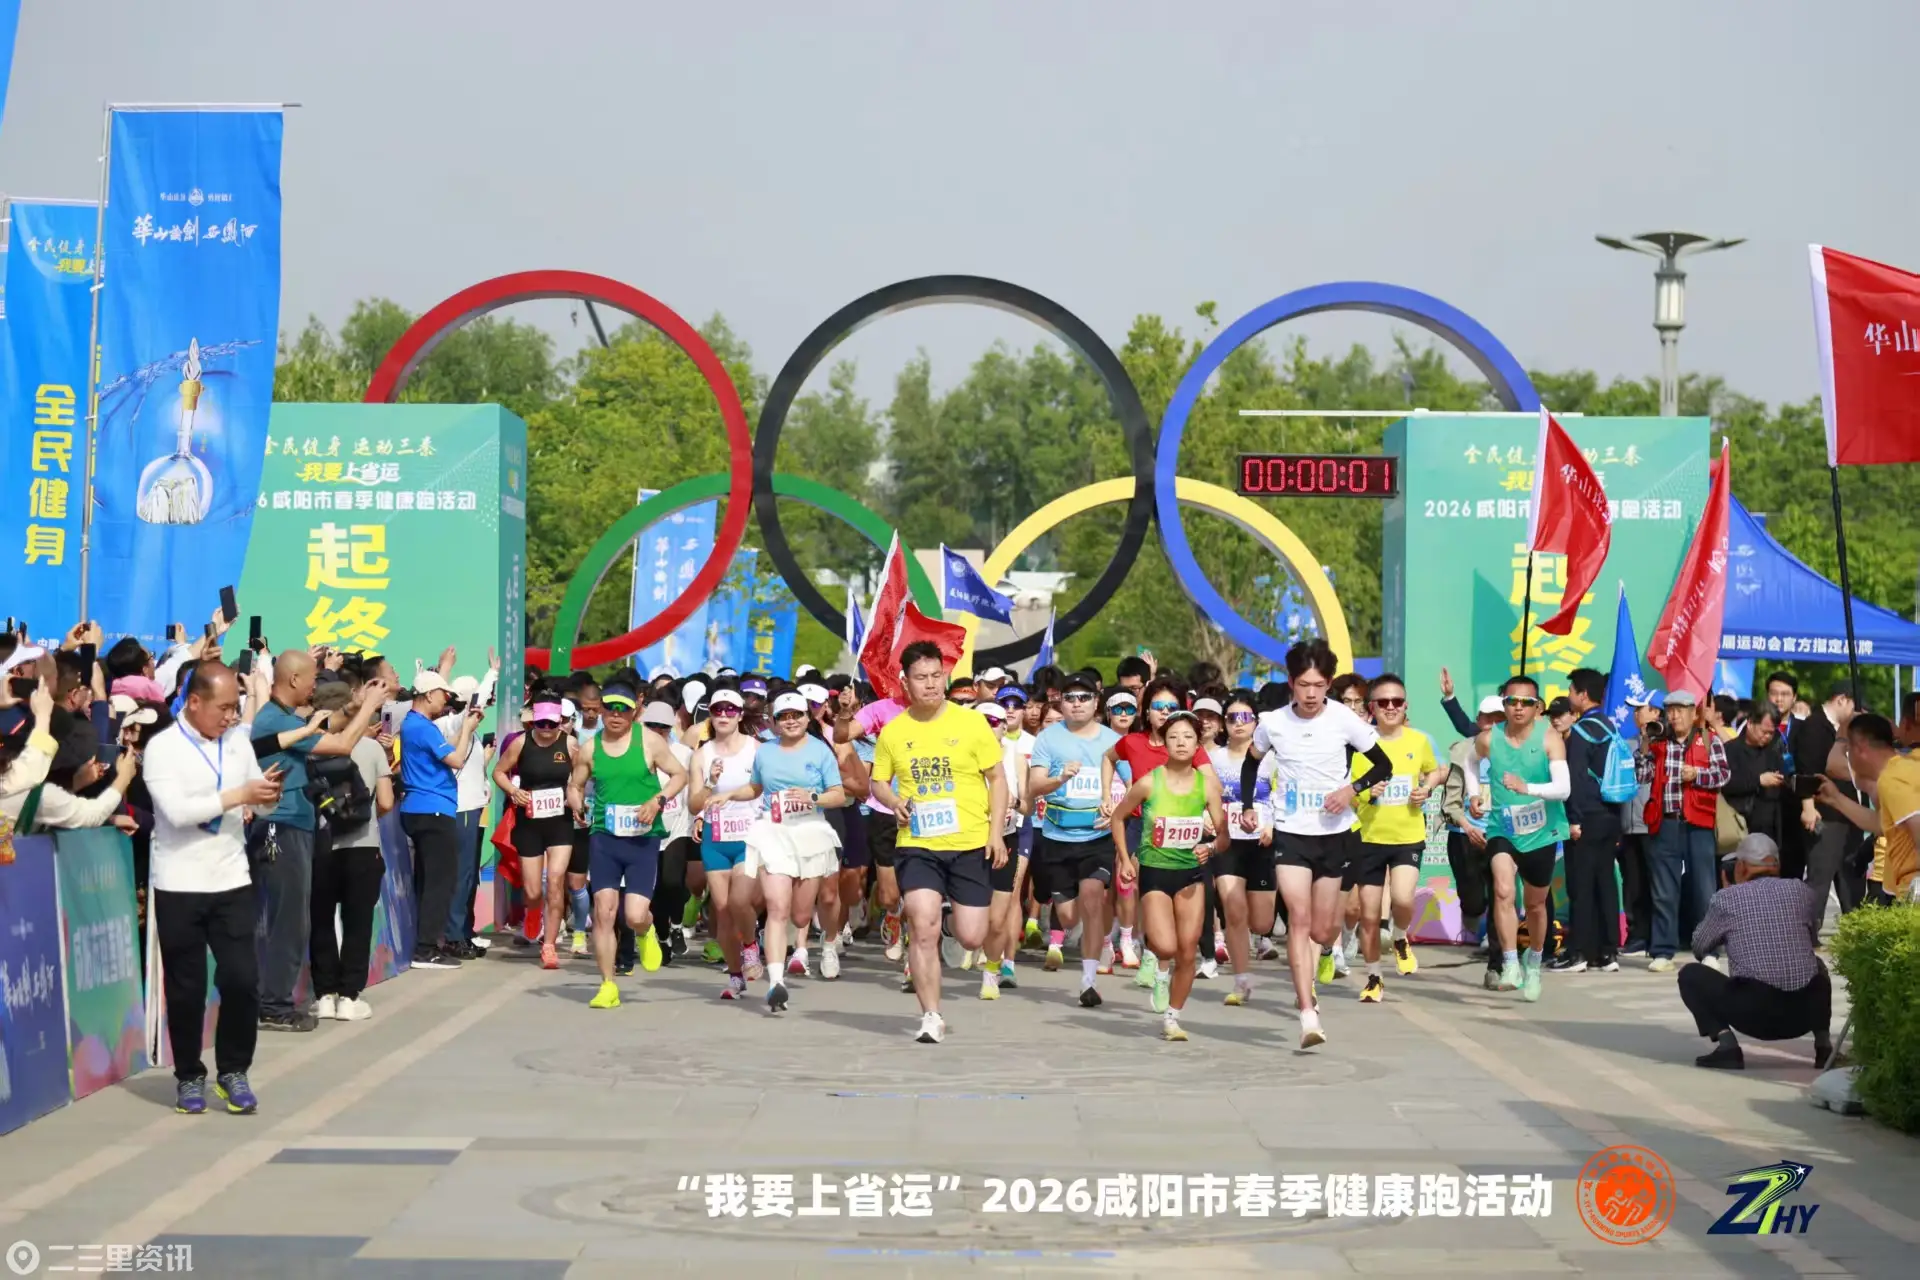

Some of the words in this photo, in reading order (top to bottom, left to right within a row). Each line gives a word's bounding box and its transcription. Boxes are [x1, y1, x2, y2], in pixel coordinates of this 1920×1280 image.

[24, 383, 76, 566] 全民健身
[1244, 458, 1390, 493] 00:00:01
[1424, 500, 1472, 518] 2026
[536, 796, 561, 810] 2102
[921, 811, 954, 828] 1283
[1168, 827, 1200, 841] 2109
